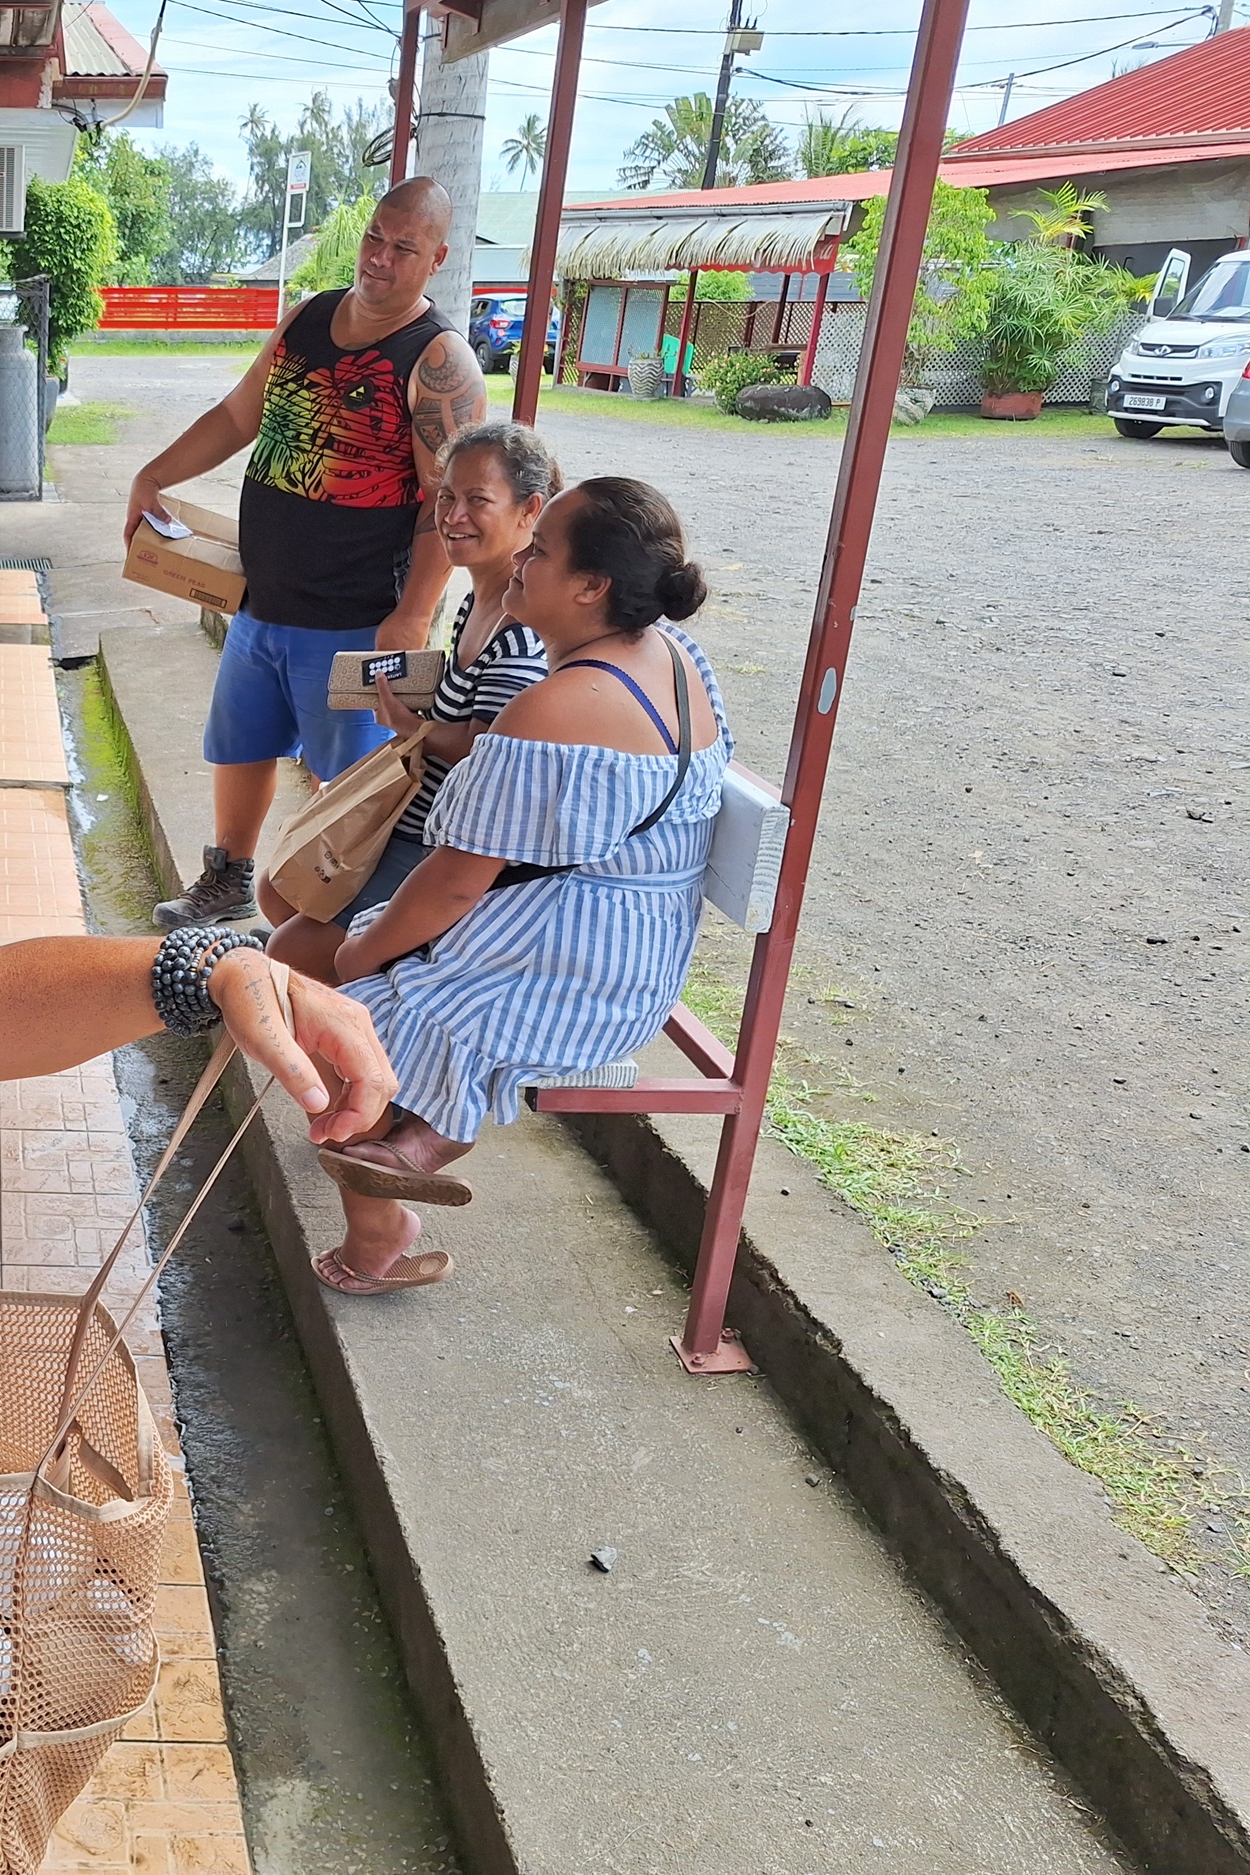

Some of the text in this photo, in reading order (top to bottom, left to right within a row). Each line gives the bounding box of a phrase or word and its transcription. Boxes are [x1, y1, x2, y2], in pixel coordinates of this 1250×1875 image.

[1155, 398, 1161, 407] P
[163, 569, 187, 583] GREEN
[188, 577, 206, 588] PEAS
